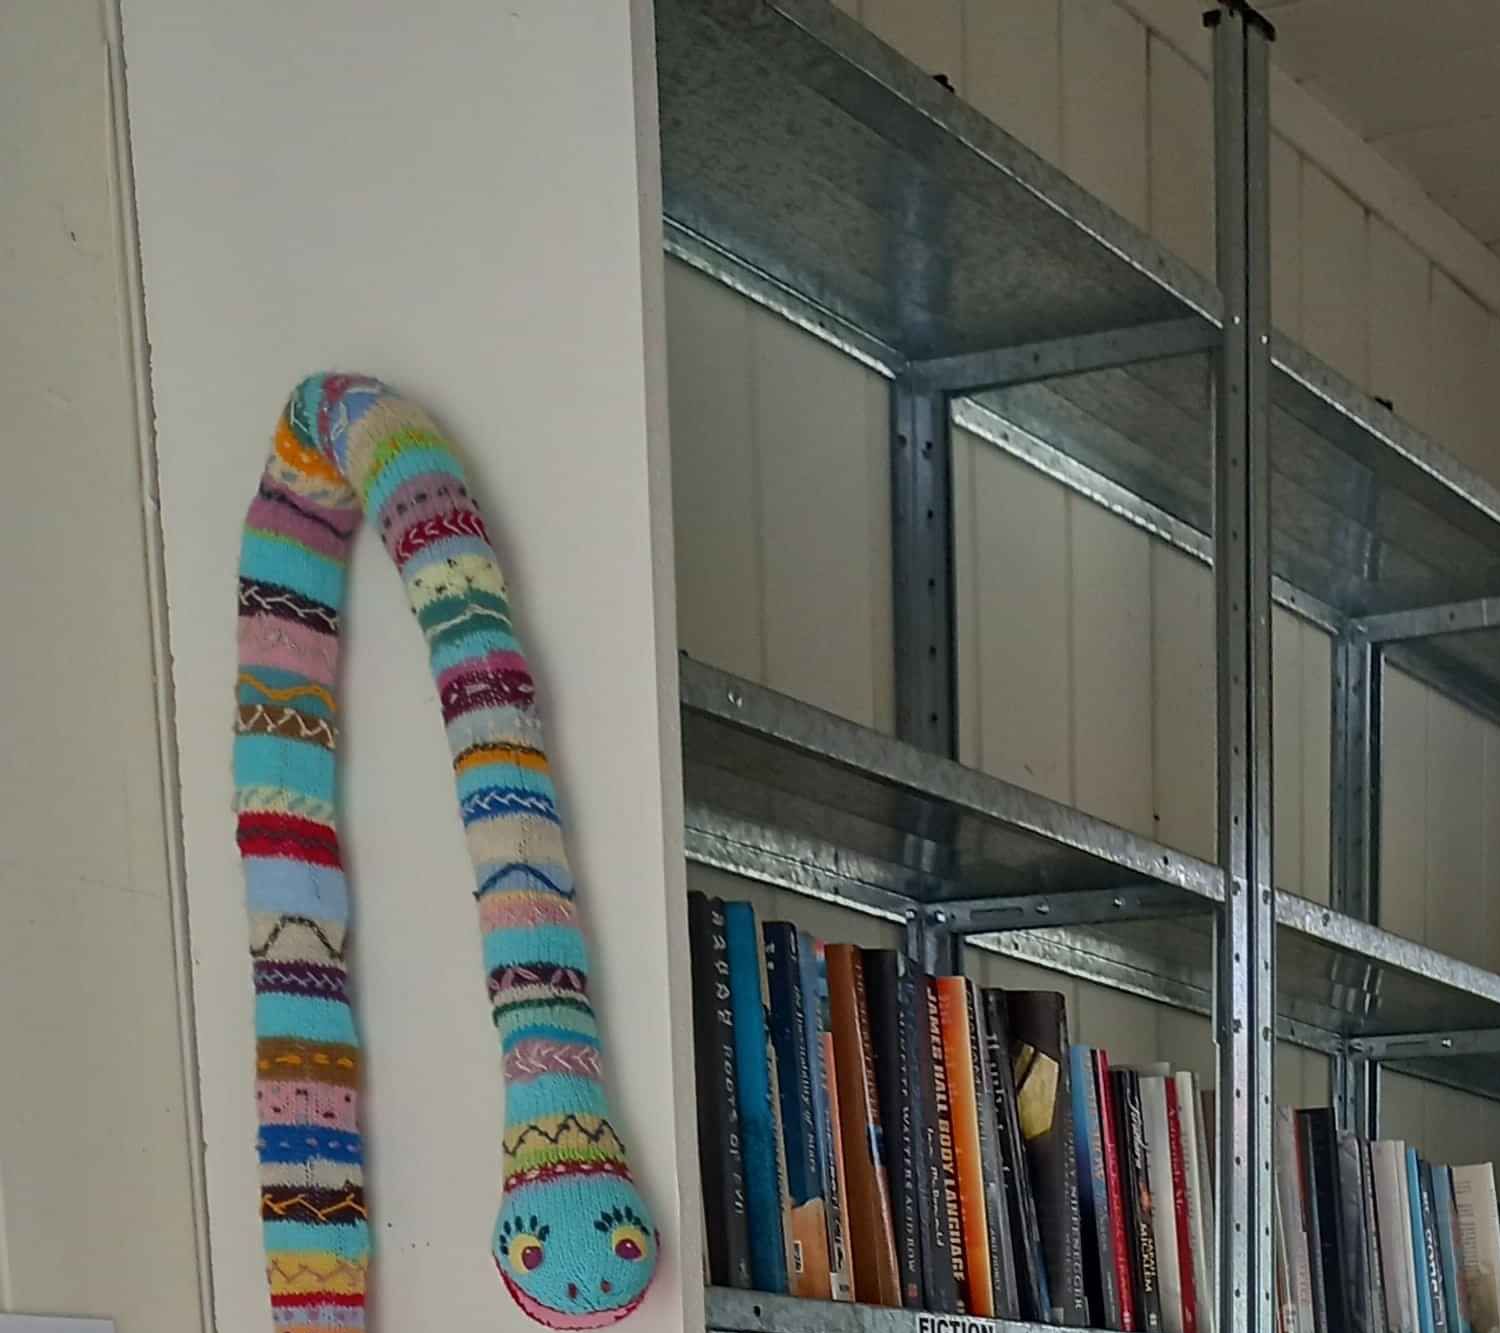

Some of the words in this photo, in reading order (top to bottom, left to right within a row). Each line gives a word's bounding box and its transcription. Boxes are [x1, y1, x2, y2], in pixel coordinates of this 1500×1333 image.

[926, 986, 945, 1061] JAMES
[934, 1064, 950, 1113] HALL
[938, 1118, 954, 1174] BODY
[943, 1177, 966, 1283] LANGUAGE
